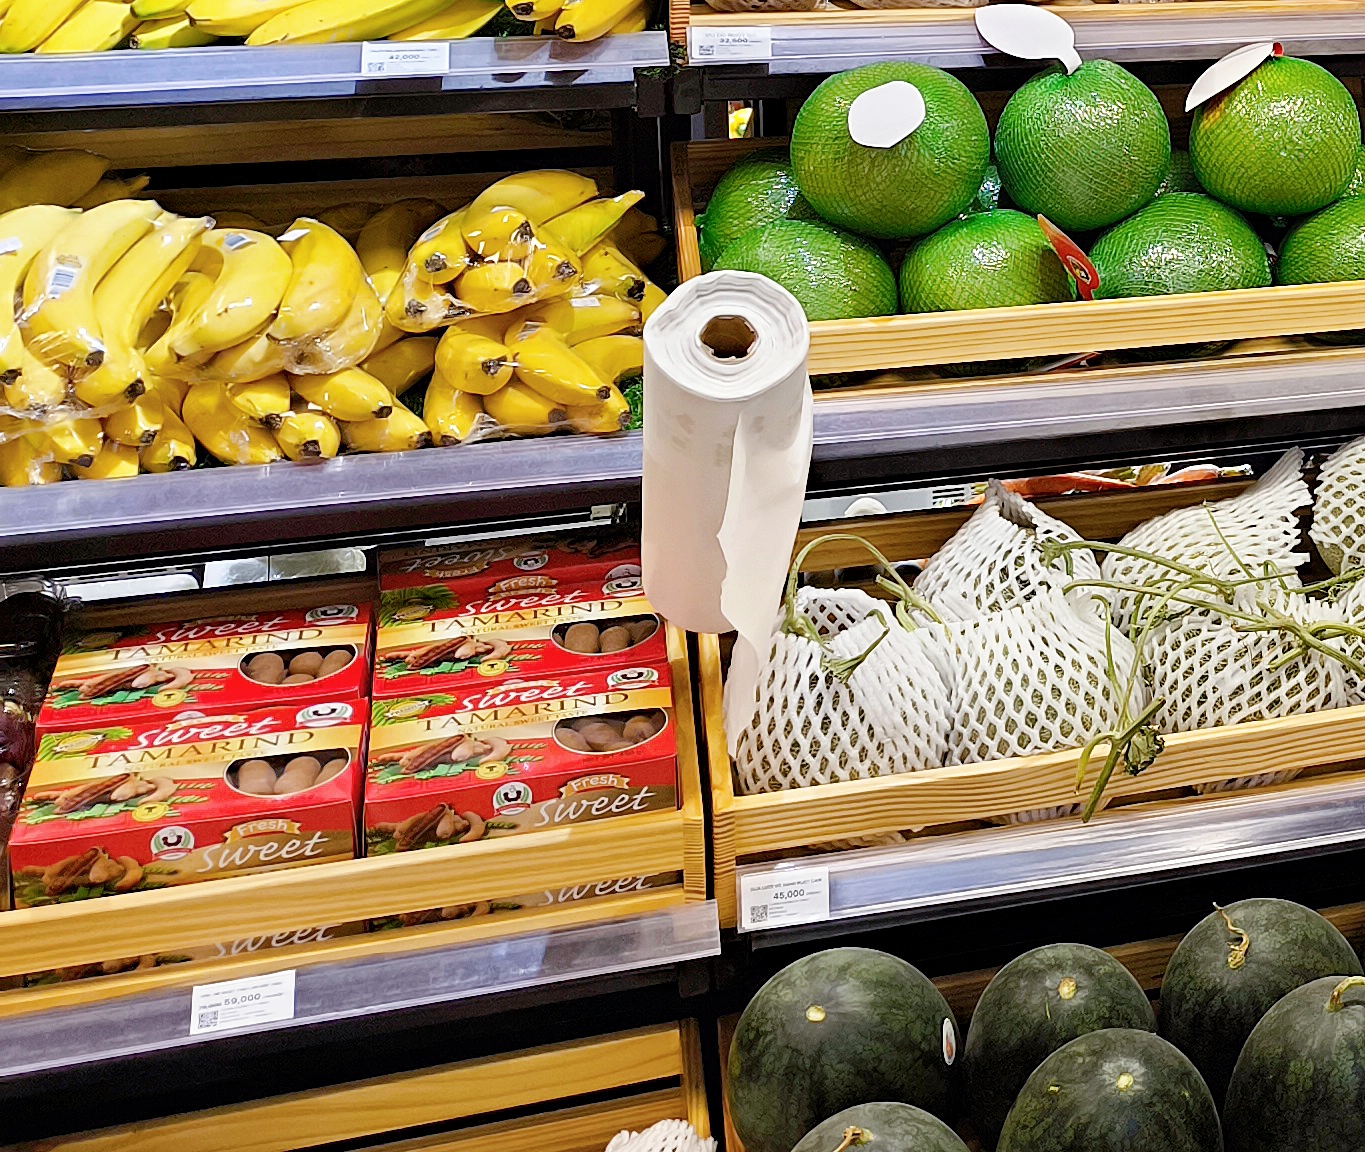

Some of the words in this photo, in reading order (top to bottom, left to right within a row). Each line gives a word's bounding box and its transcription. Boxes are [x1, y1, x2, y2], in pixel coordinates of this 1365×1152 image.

[500, 575, 547, 590] Fresh
[421, 599, 624, 633] TAMARIND
[111, 628, 324, 661] TAMARIND
[416, 692, 630, 732] TAMARIND
[88, 730, 315, 770] TAMARIND
[570, 774, 618, 792] Fresh
[237, 819, 289, 836] Fresh
[773, 888, 805, 900] 45,000
[223, 992, 261, 1007] 59,000
